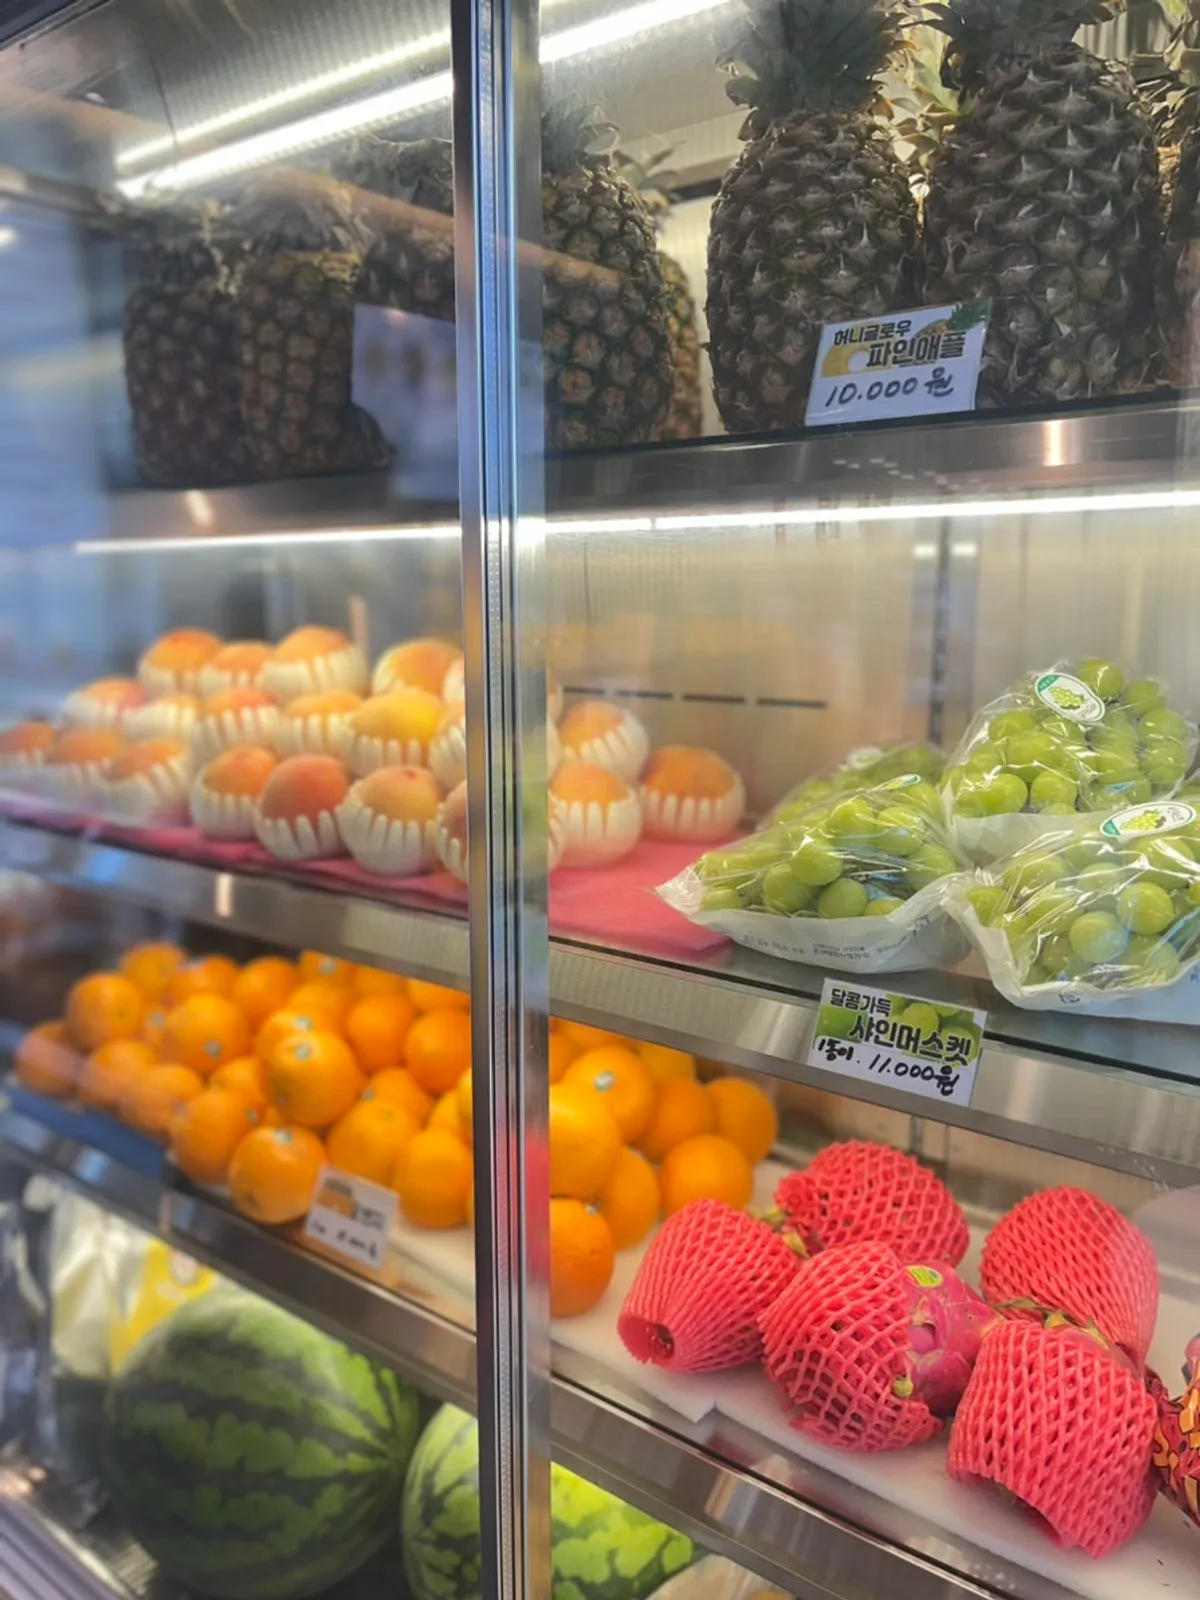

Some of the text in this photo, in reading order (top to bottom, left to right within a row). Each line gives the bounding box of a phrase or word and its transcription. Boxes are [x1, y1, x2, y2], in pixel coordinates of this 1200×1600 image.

[834, 319, 912, 346] 허니글로우
[866, 331, 967, 368] 파인애플
[830, 987, 892, 1017] 달콤가득
[849, 1015, 972, 1066] 샤인머스켓
